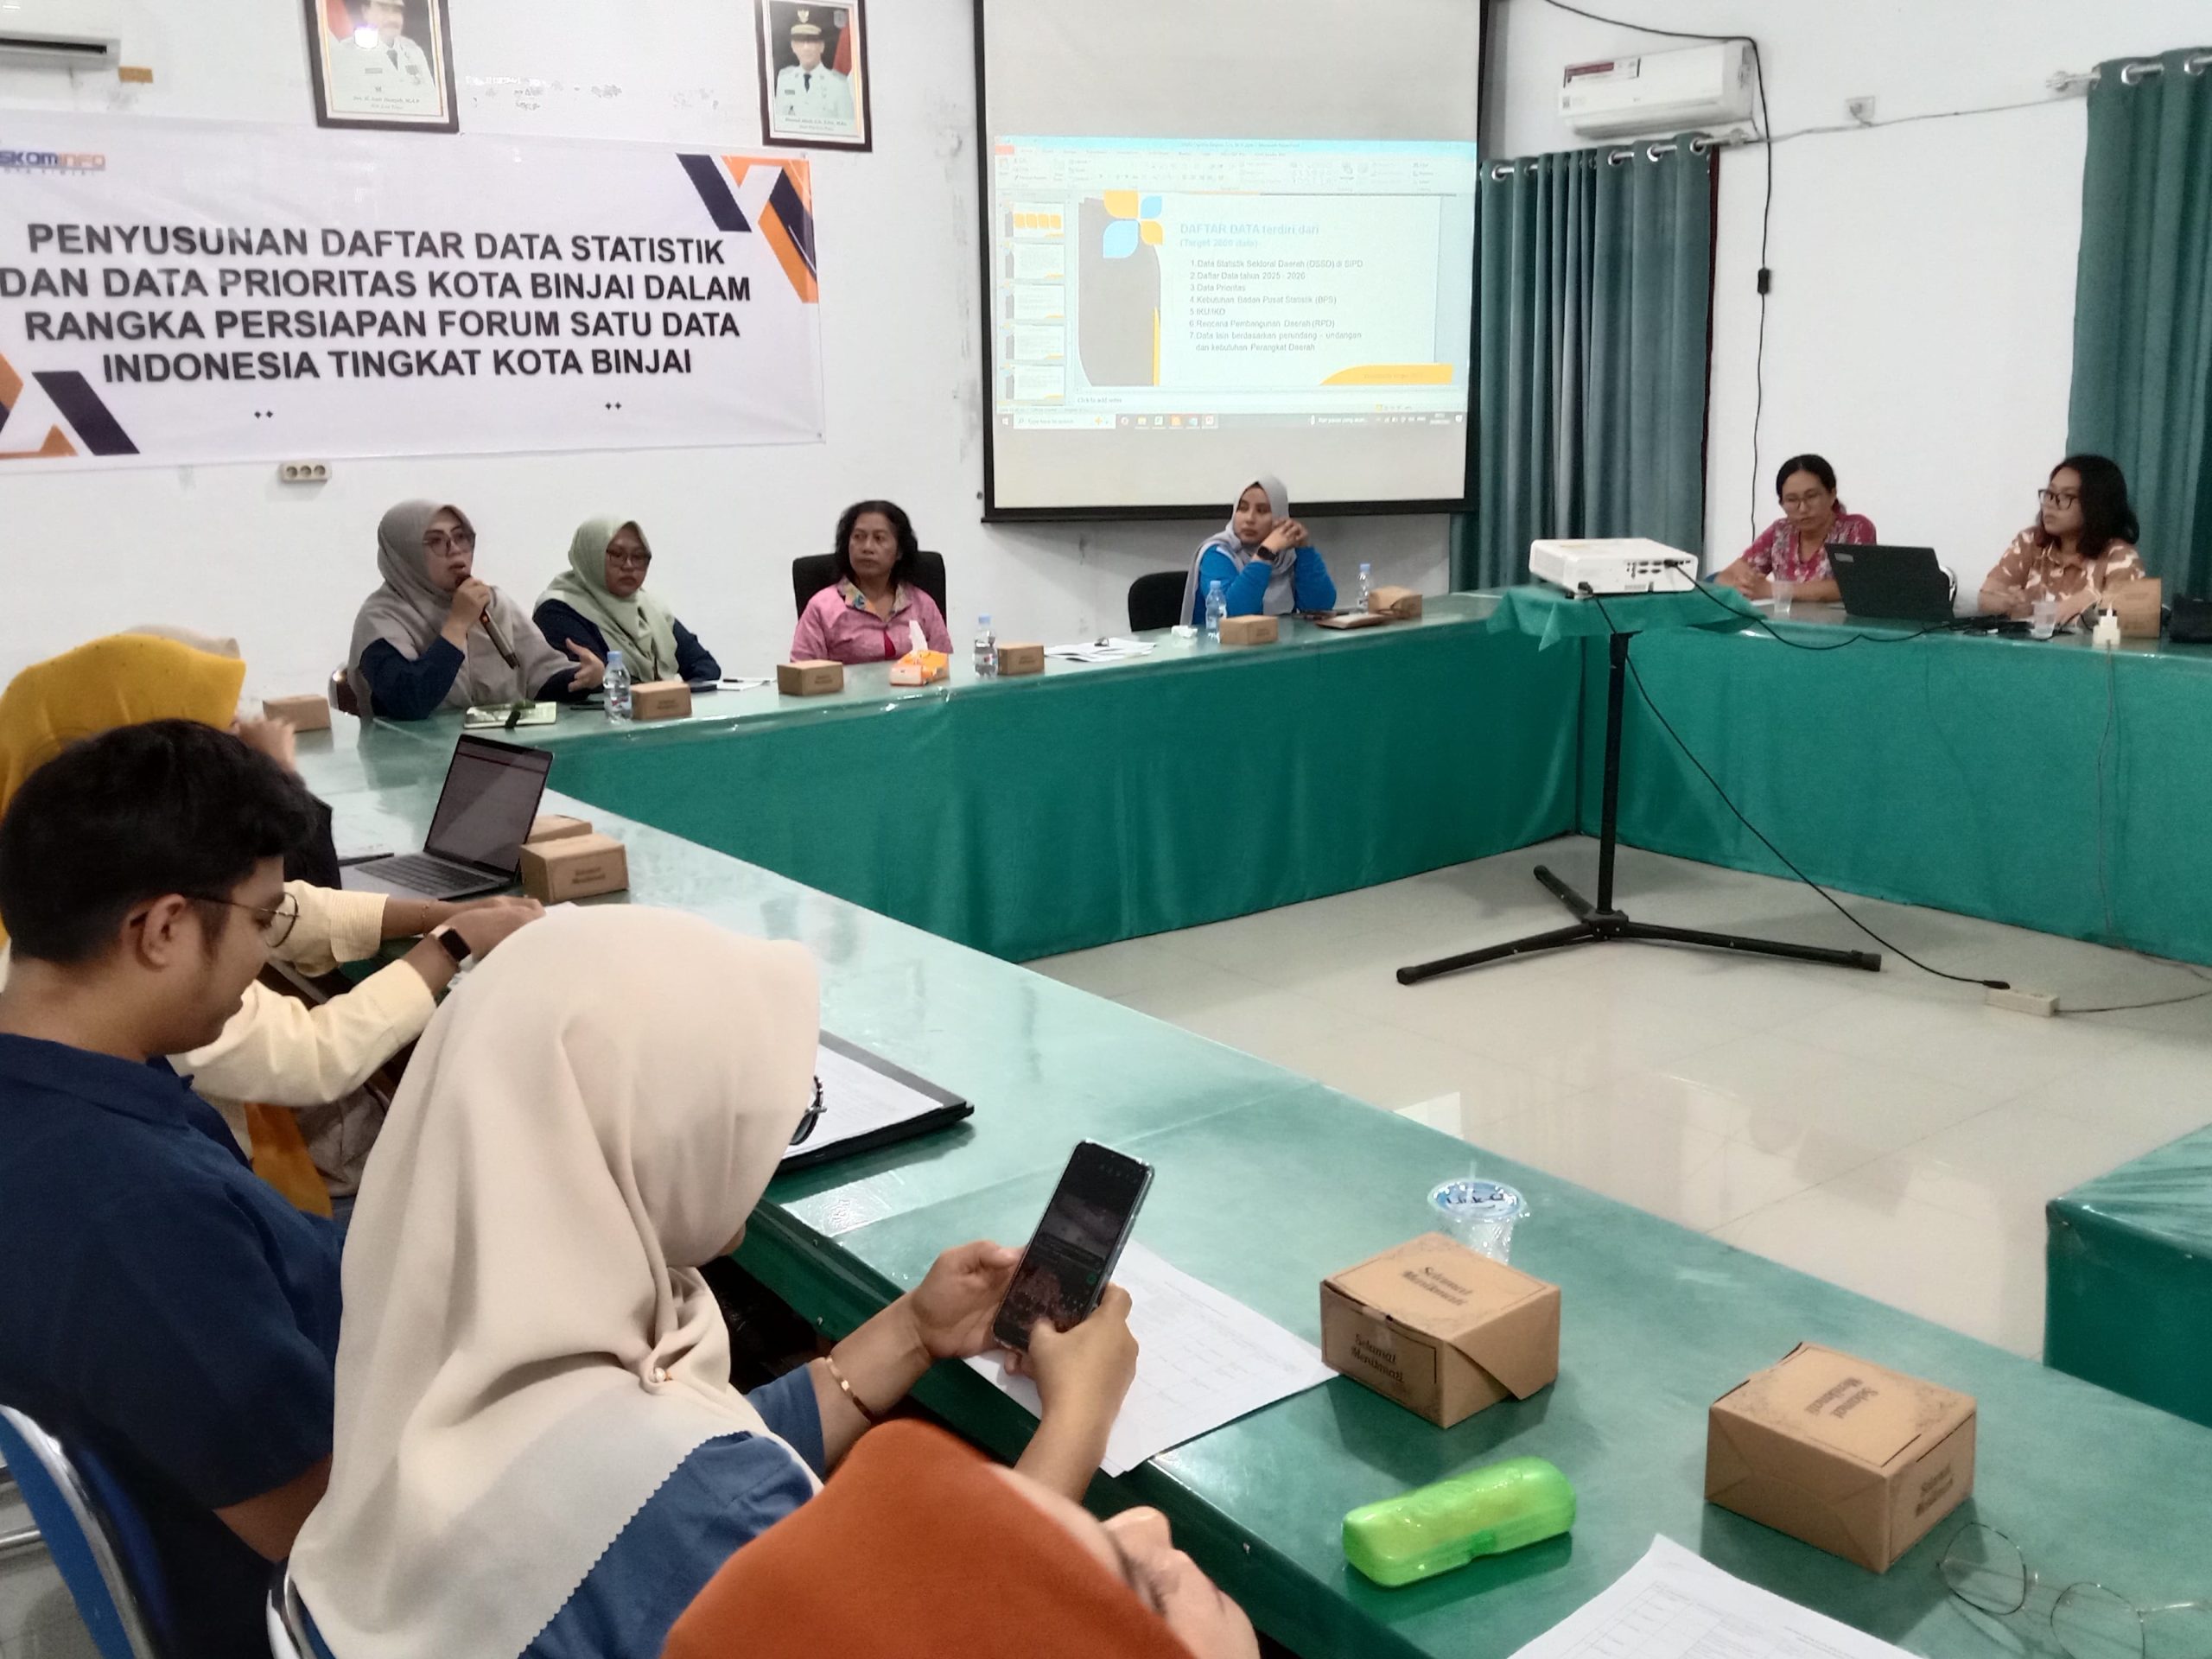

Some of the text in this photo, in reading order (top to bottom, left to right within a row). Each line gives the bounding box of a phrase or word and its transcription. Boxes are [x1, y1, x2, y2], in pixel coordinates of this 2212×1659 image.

[1180, 223, 1319, 235] DAFTAR DATA terdiri dari
[27, 222, 725, 264] PENYUSUNAN DAFTAR DATA STATISTIK
[1217, 259, 1244, 268] Statistik
[1246, 259, 1276, 268] Sektoral
[1278, 259, 1305, 268] Daerah
[1221, 271, 1238, 280] Data
[1240, 271, 1260, 280] tahun
[1, 267, 752, 302] DAN DATA PRIORITAS KOTA BINJAI DALAM
[1216, 283, 1246, 292] Prioritas
[1237, 296, 1261, 304] Badan
[1262, 296, 1283, 304] Pusat
[1285, 296, 1313, 304] Statistik
[24, 309, 741, 341] RANGKA PERSIAPAN FORUM SATU DATA
[1230, 320, 1281, 329] Pembangunan
[1216, 331, 1229, 340] lain
[1231, 331, 1276, 340] berdasarkan
[1279, 331, 1318, 341] perundang
[1325, 331, 1362, 340] undangan
[1211, 343, 1248, 352] kebutuhan
[1250, 343, 1287, 353] Perangkat
[1288, 342, 1315, 352] Daerah
[103, 348, 692, 383] INDONESIA TINGKAT KOTA BINJAI
[1424, 1266, 1473, 1294] Selamat
[1355, 1333, 1396, 1363] Selamat
[1351, 1345, 1404, 1382] Menikmati
